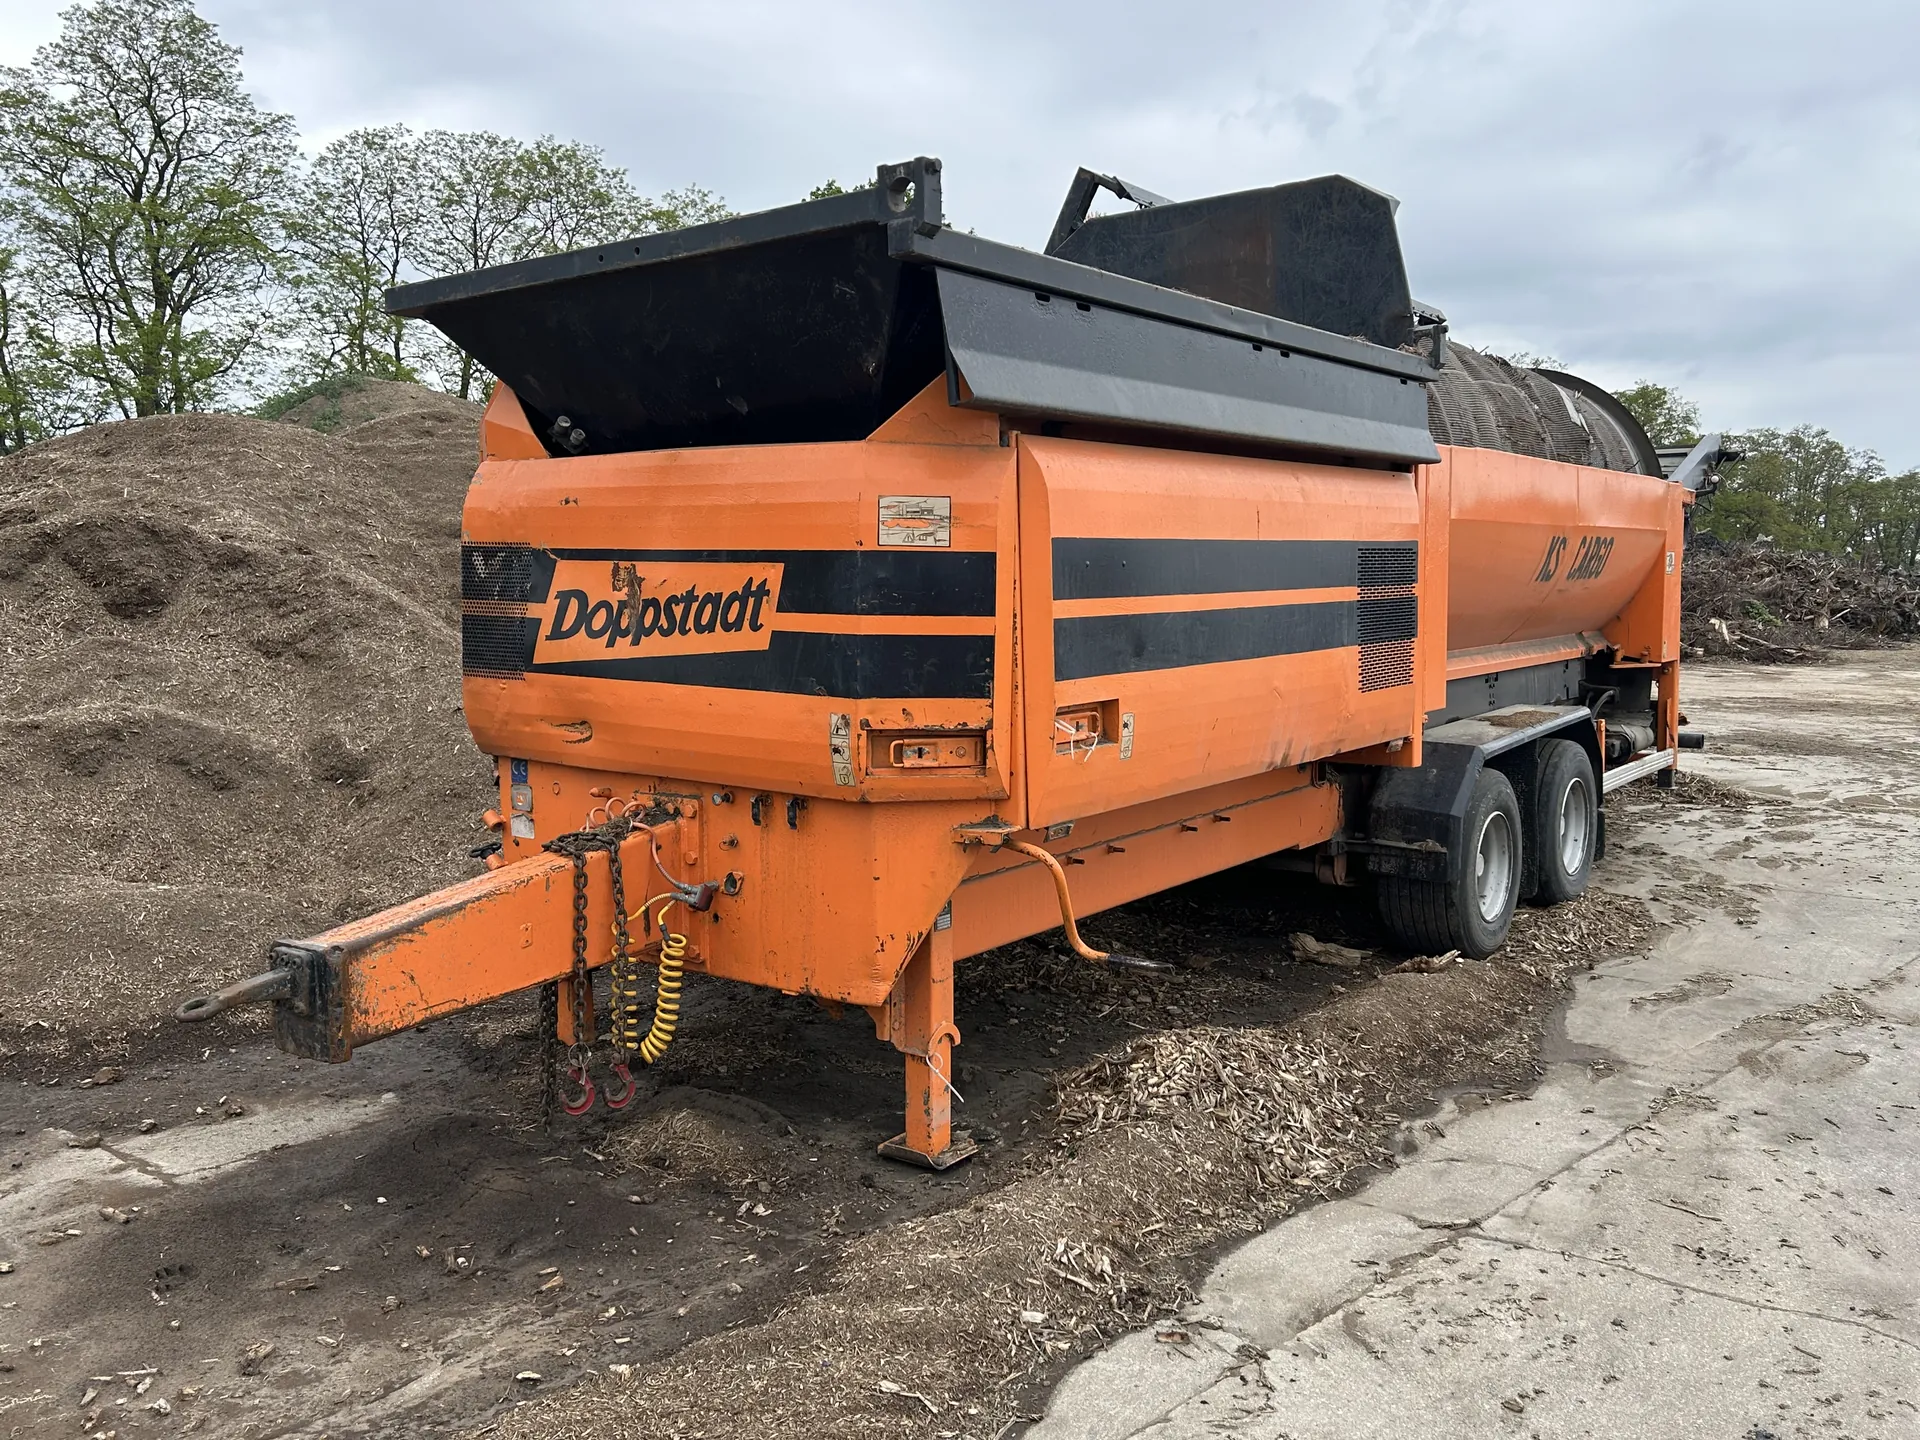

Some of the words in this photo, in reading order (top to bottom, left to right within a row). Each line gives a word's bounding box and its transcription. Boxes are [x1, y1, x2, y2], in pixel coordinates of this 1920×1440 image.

[1534, 535, 1567, 582] KS
[1566, 535, 1615, 580] CARGO
[545, 576, 771, 648] Doppstadt
